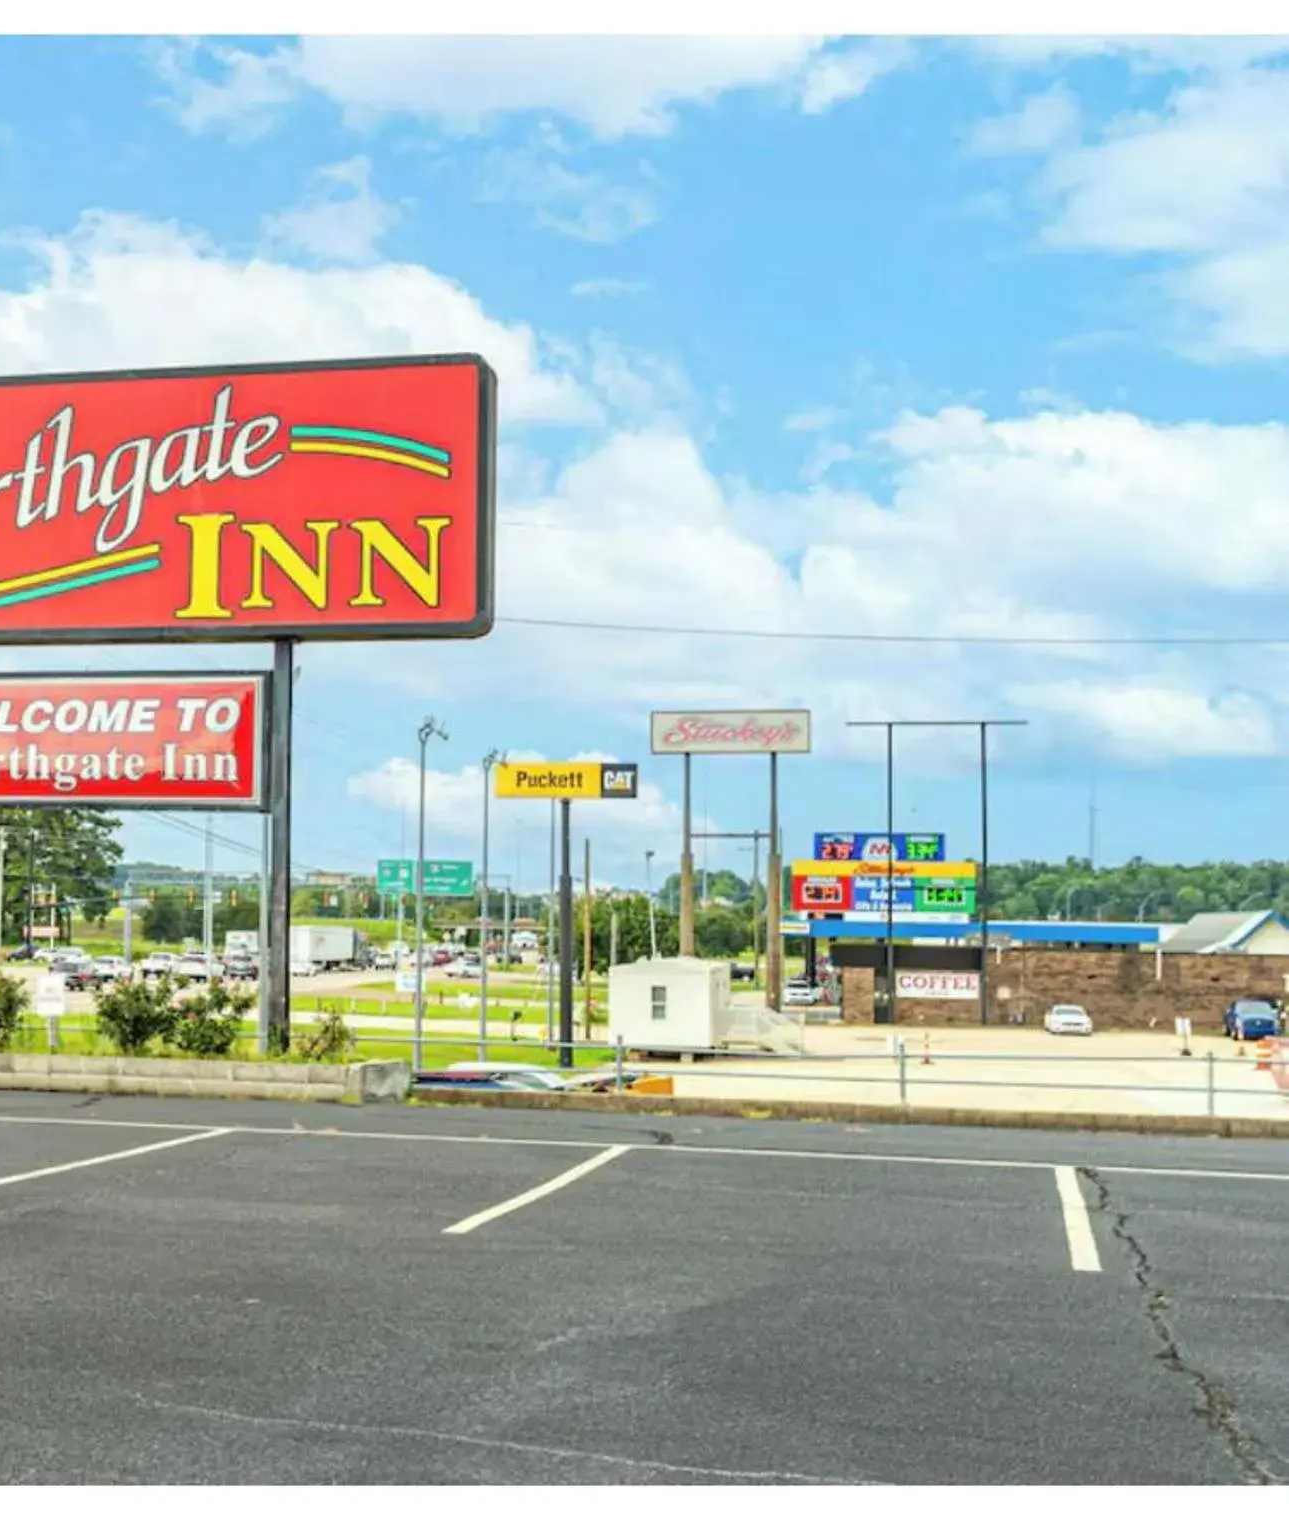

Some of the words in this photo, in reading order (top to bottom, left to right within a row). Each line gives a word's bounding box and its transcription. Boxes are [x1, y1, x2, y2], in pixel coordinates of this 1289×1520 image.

[175, 512, 452, 619] INN
[176, 697, 240, 733] TO
[160, 741, 240, 783] Inn
[515, 770, 583, 788] Puckett
[603, 771, 635, 790] CAT
[899, 975, 977, 990] COFFEE
